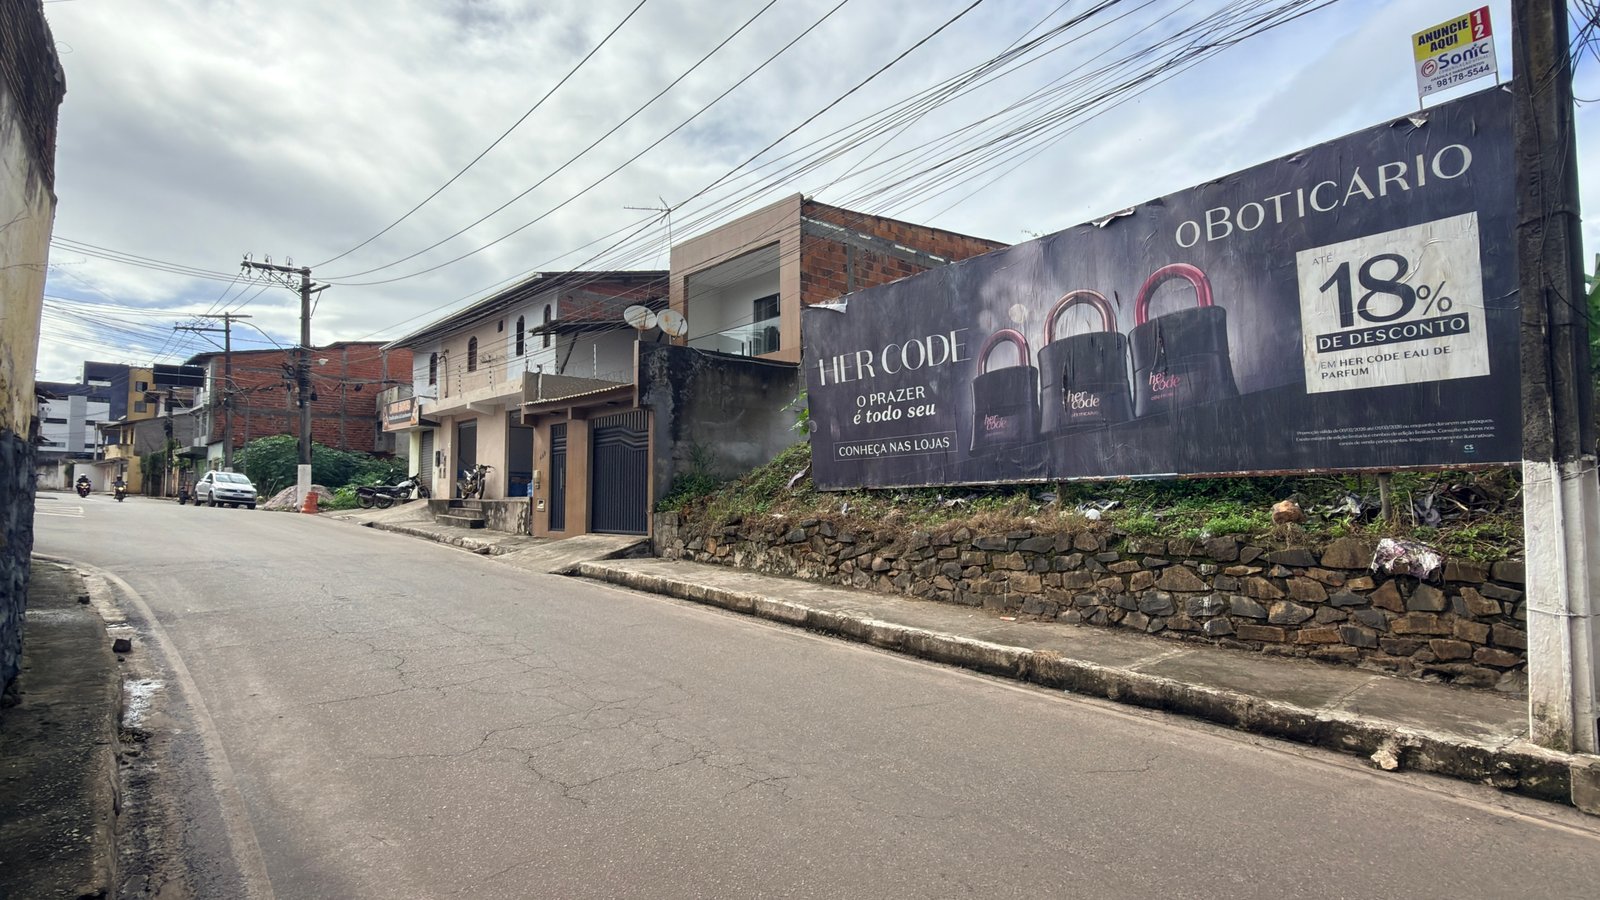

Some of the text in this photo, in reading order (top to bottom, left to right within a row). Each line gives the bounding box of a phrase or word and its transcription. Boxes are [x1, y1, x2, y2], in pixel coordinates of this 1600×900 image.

[1474, 10, 1482, 24] 1
[1418, 18, 1468, 46] ANUNCIE
[1474, 24, 1484, 39] 2
[1430, 34, 1458, 52] AQUI
[1438, 43, 1488, 69] Sonic
[1436, 64, 1490, 88] 98178-5544
[1312, 252, 1333, 265] ATÉ
[1319, 253, 1452, 328] 18%
[1319, 317, 1465, 350] DE DESCONTO
[818, 328, 971, 386] HER CODE
[1320, 346, 1450, 370] EM HER CODE EAU DE
[1322, 367, 1369, 380] PARFUM
[856, 386, 925, 407] O PRAZER
[1067, 390, 1087, 402] her
[1072, 394, 1100, 410] code
[853, 403, 936, 424] é todo seu
[839, 437, 950, 457] CONHEÇA NAS LOJAS
